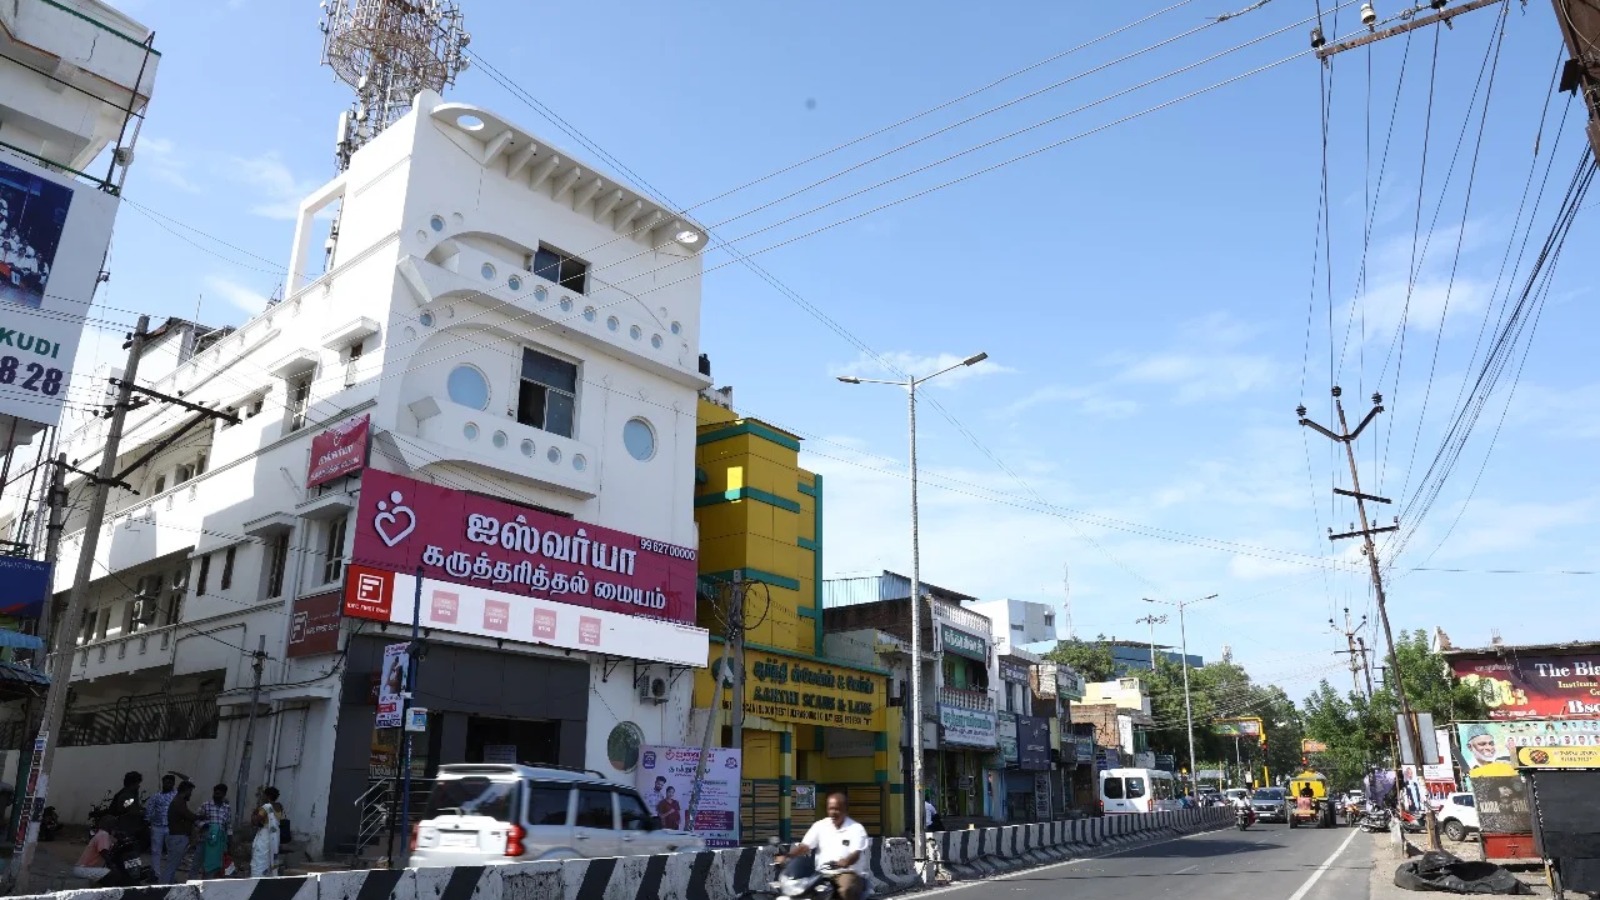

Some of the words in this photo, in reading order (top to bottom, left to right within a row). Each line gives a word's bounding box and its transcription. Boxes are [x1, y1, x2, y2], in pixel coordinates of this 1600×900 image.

[467, 513, 637, 576] ஐஸ்வர்யா
[423, 544, 589, 595] கருத்தரித்தல்
[595, 579, 666, 610] மையம்
[1534, 663, 1571, 678] The
[802, 692, 836, 712] SCANS
[837, 698, 846, 713] &
